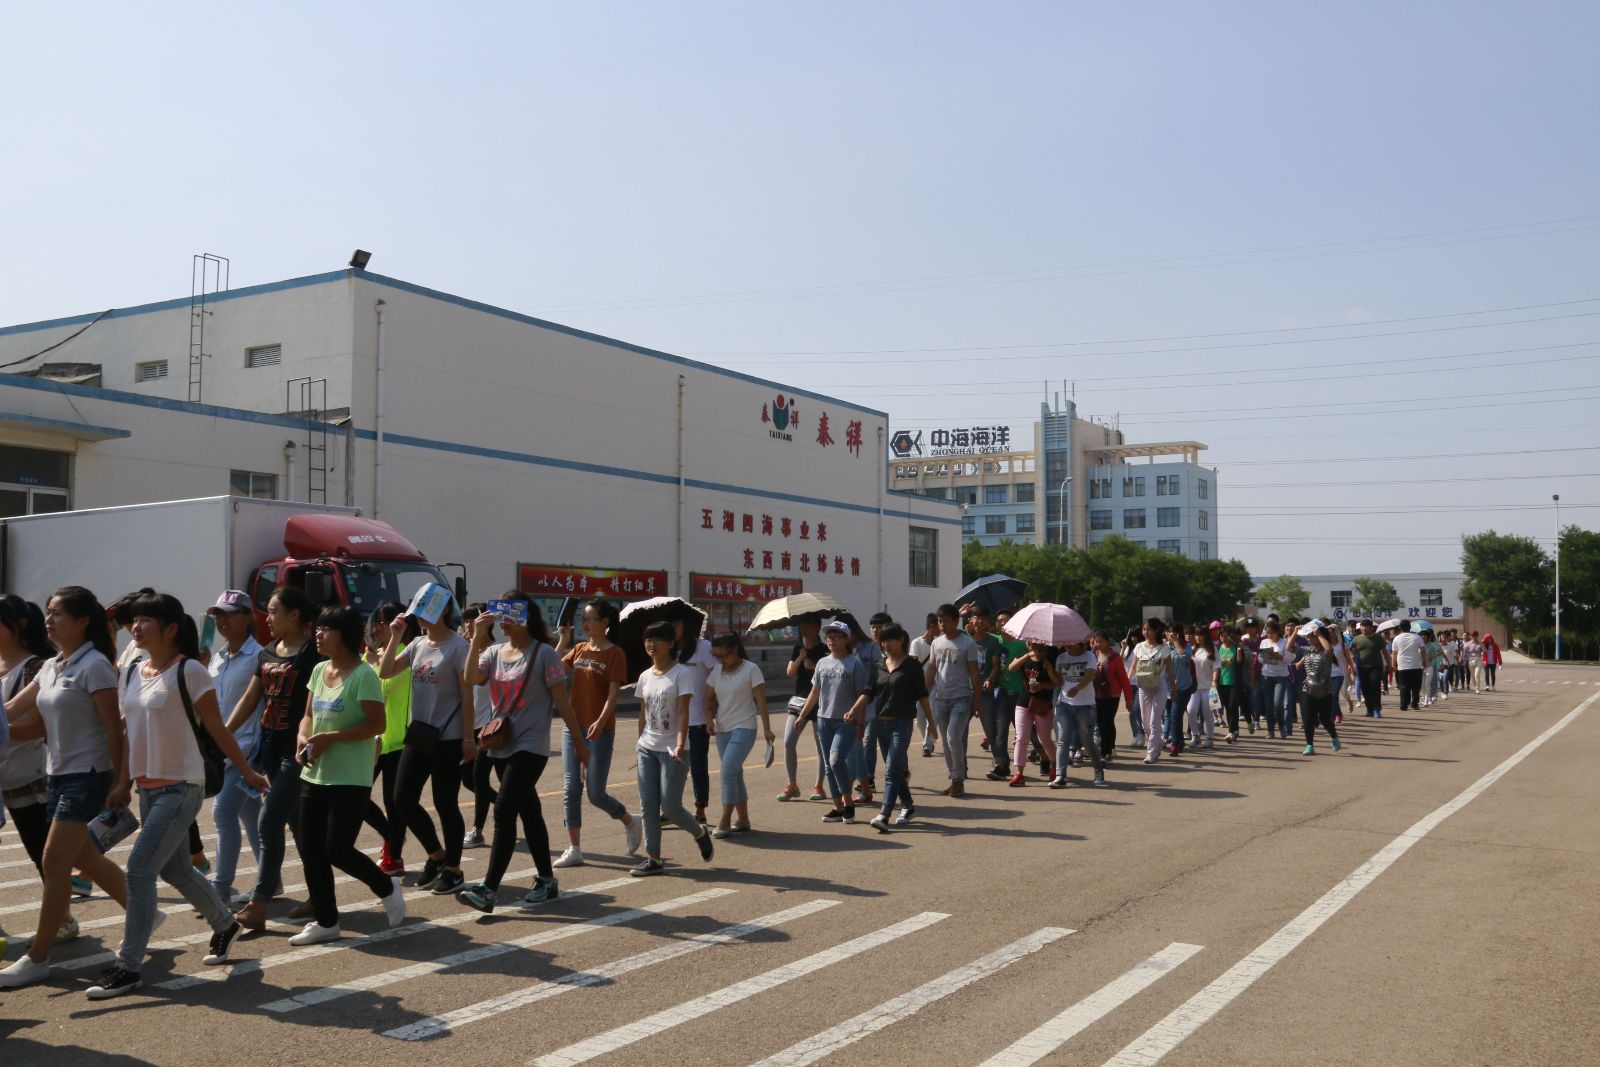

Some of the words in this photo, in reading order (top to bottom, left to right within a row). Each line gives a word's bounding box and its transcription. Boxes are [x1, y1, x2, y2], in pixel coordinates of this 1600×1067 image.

[815, 411, 864, 459] 泰祥
[930, 425, 1010, 447] 中海海洋
[930, 448, 975, 456] ZHONGHAI
[978, 445, 1010, 454] OCEAN
[701, 508, 827, 542] 五湖四海事业来
[538, 574, 588, 592] 以人为本
[610, 576, 657, 595] 精打细算
[1408, 606, 1453, 618] 欢迎您
